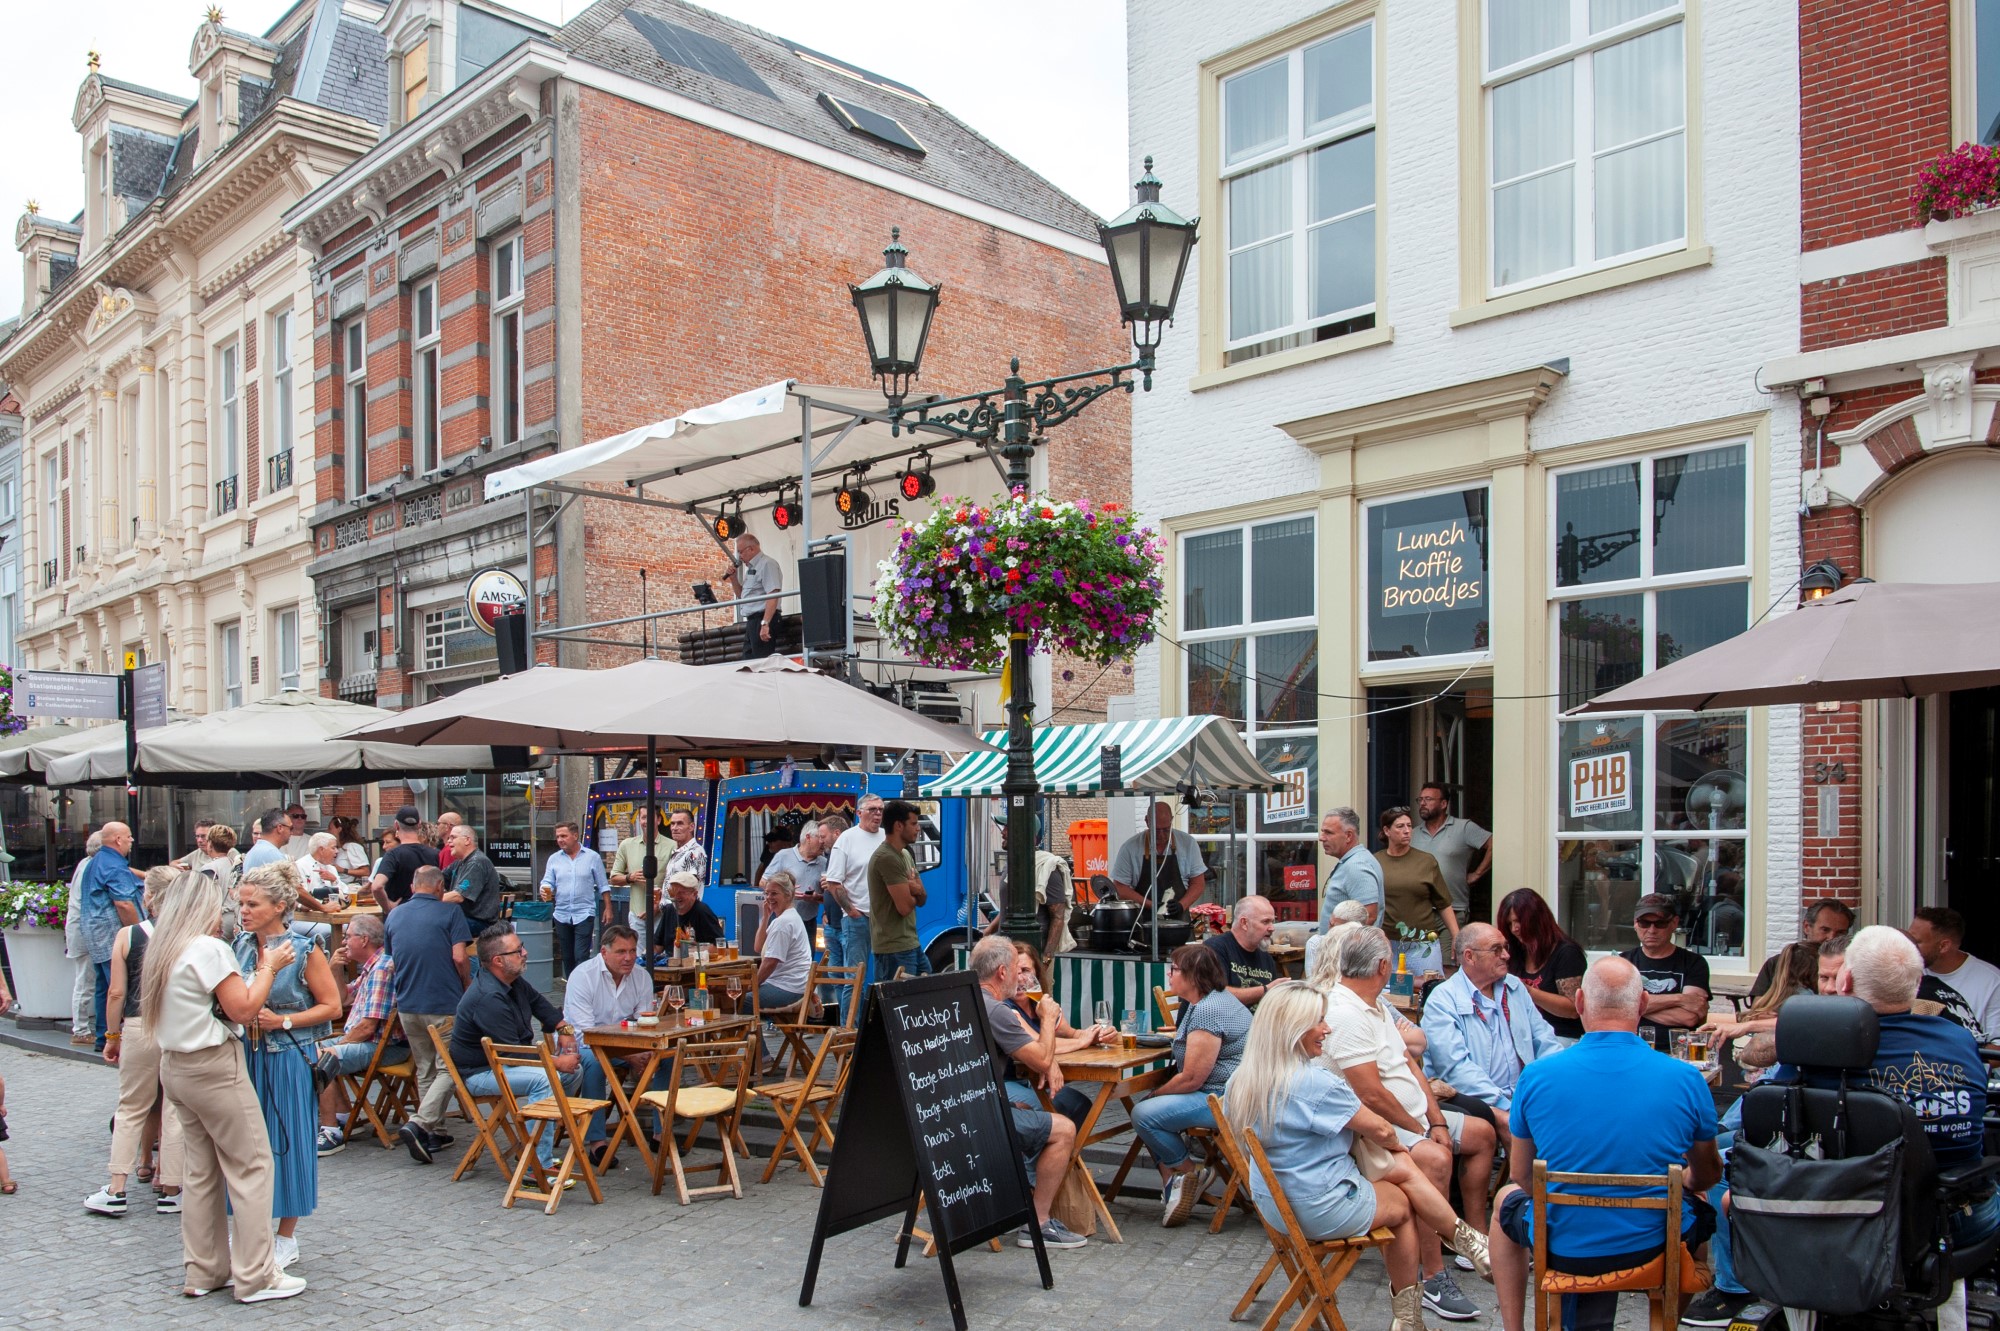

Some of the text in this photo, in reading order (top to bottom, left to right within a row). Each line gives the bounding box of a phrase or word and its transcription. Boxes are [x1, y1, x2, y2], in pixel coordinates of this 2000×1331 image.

[1397, 521, 1465, 552] Lunch
[1399, 550, 1463, 581] Koffie
[1383, 577, 1480, 608] Broodjes
[28, 674, 98, 685] Gouvernementsplein
[28, 682, 74, 691] Stationsplein
[1574, 756, 1625, 801] PHB
[1814, 761, 1847, 783] 34
[1575, 804, 1589, 813] PRINS
[1589, 801, 1609, 811] HEERLIJK
[499, 851, 512, 859] POOL
[894, 1004, 951, 1031] Truckstop
[902, 1040, 923, 1058] Prins
[909, 1071, 939, 1094] Broodje
[915, 1103, 942, 1124] Broodje
[1940, 1121, 1972, 1133] WORLD
